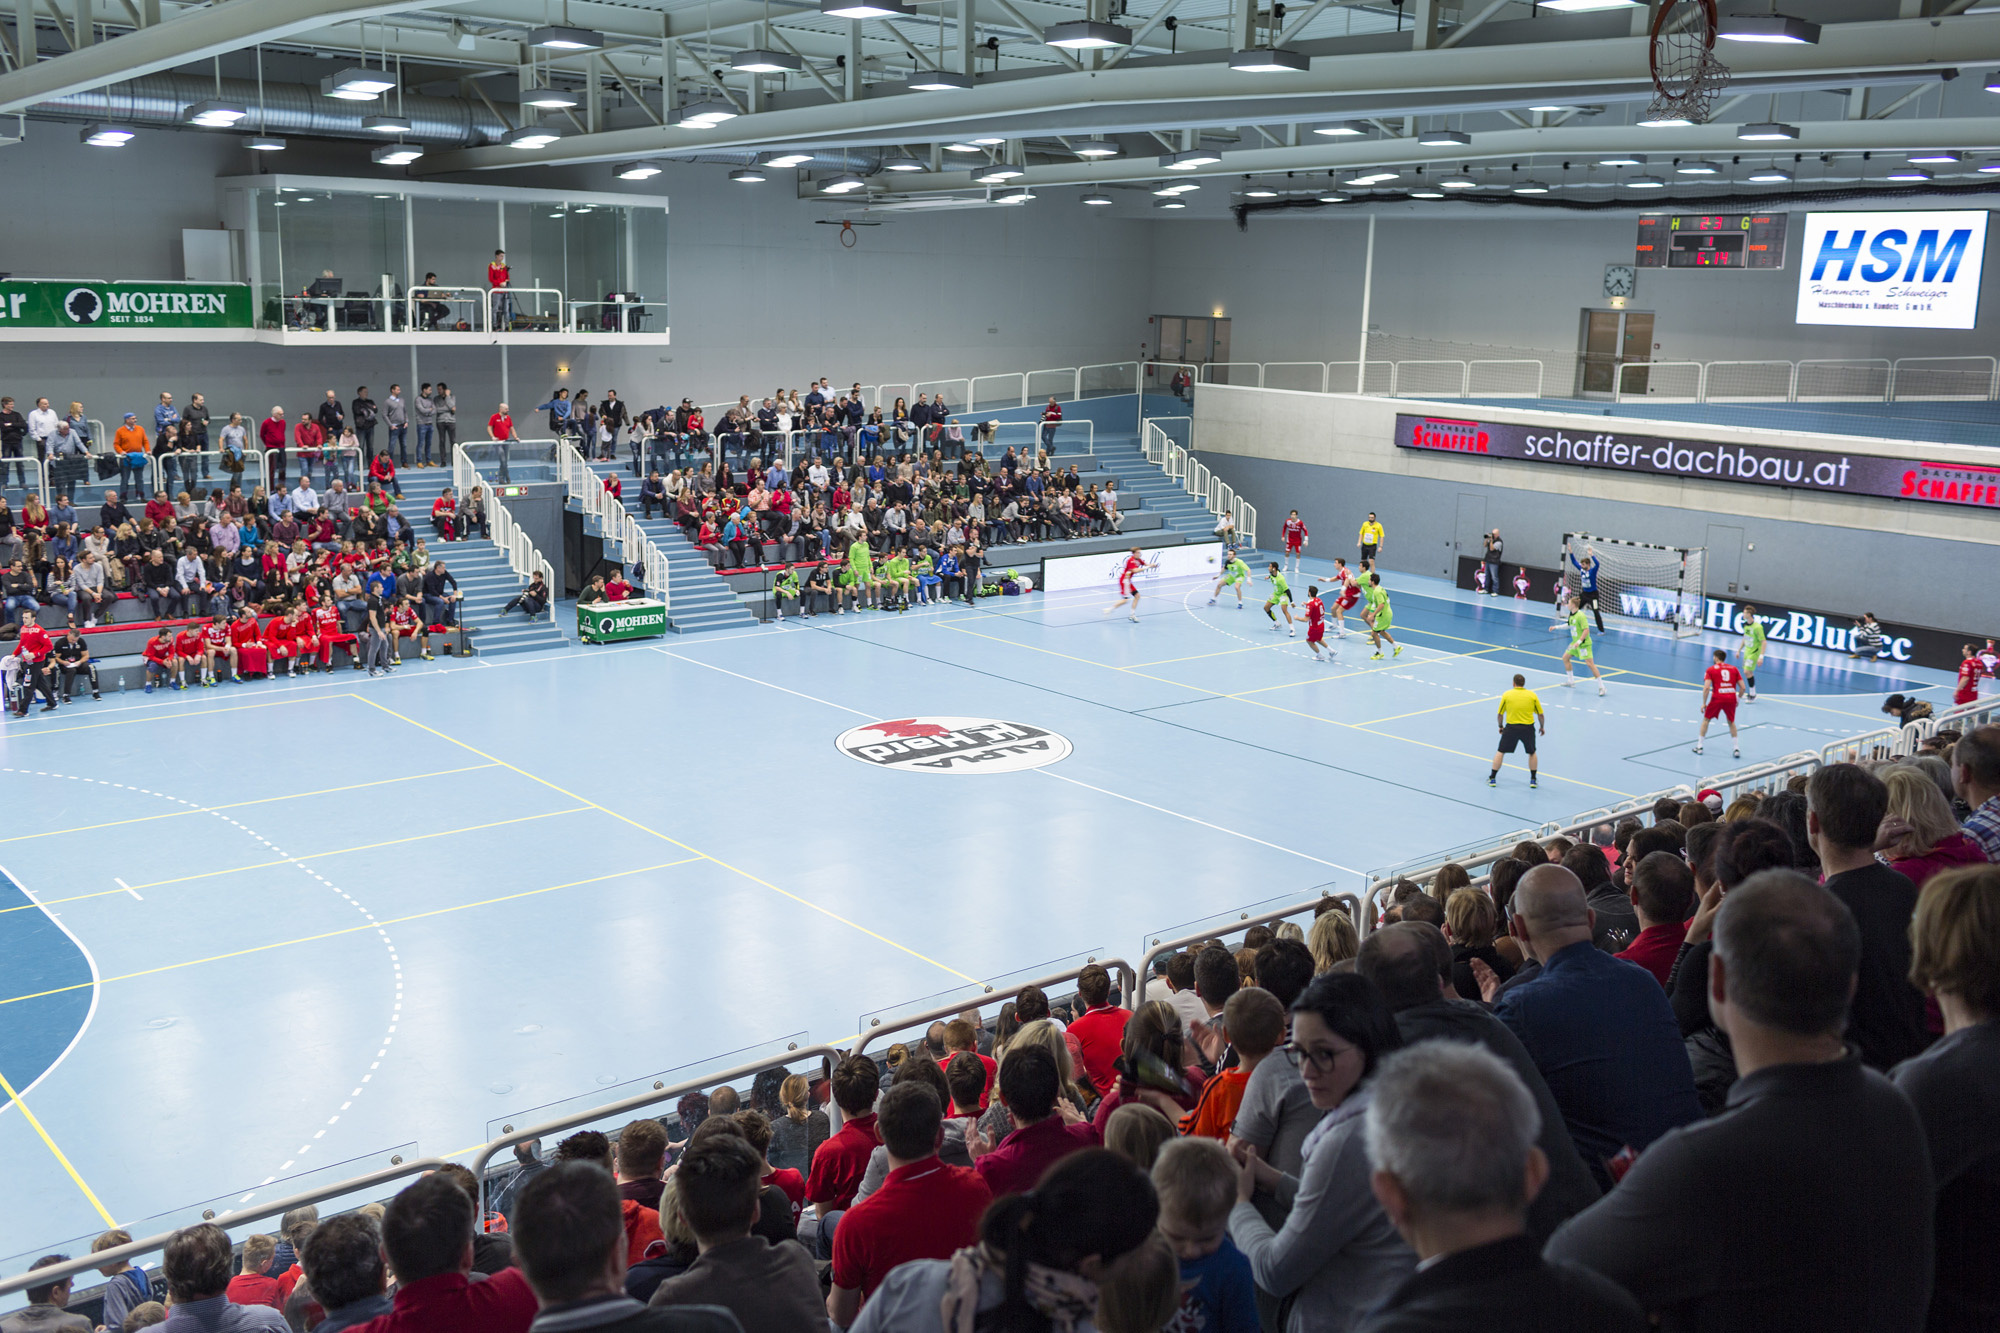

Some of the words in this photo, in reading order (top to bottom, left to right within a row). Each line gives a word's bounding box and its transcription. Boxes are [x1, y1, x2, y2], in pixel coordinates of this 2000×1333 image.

[1671, 217, 1680, 230] H
[1741, 216, 1750, 230] G
[1809, 229, 1973, 283] HSM
[1811, 284, 1871, 297] Hammerer
[1886, 287, 1949, 301] Schweiger
[106, 292, 227, 314] MOHREN
[1426, 423, 1475, 434] DACHBAU
[1412, 425, 1490, 454] SCHAFFER
[1524, 431, 1851, 487] schaffer-dachbau.at
[1922, 468, 1996, 483] DACHBAU
[1901, 470, 2000, 505] SCHAFFE
[615, 613, 664, 629] MOHREN
[1720, 669, 1731, 682] 9
[858, 734, 978, 762] Hard
